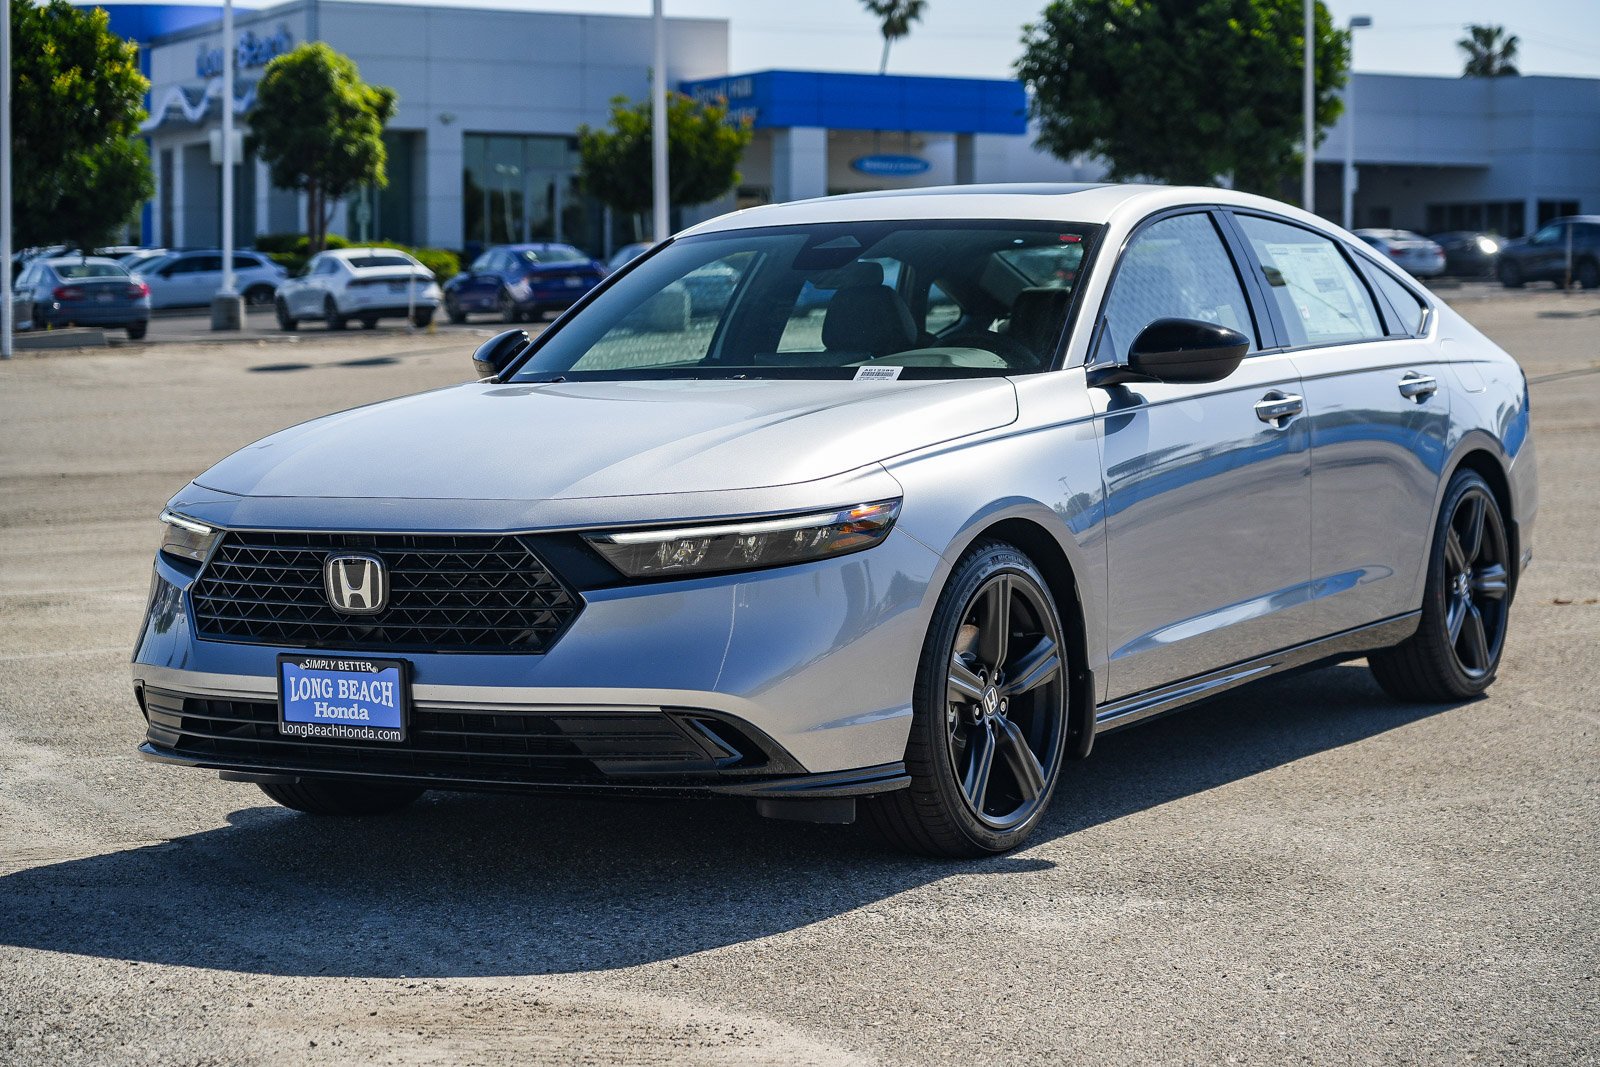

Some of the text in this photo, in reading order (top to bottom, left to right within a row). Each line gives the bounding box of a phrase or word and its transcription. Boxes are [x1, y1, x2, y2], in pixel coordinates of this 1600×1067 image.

[305, 659, 372, 672] SIMPLY BETTER
[290, 676, 394, 708] LONG BEACH
[314, 701, 370, 720] Honda
[281, 721, 401, 740] LongBeachHonda.com
